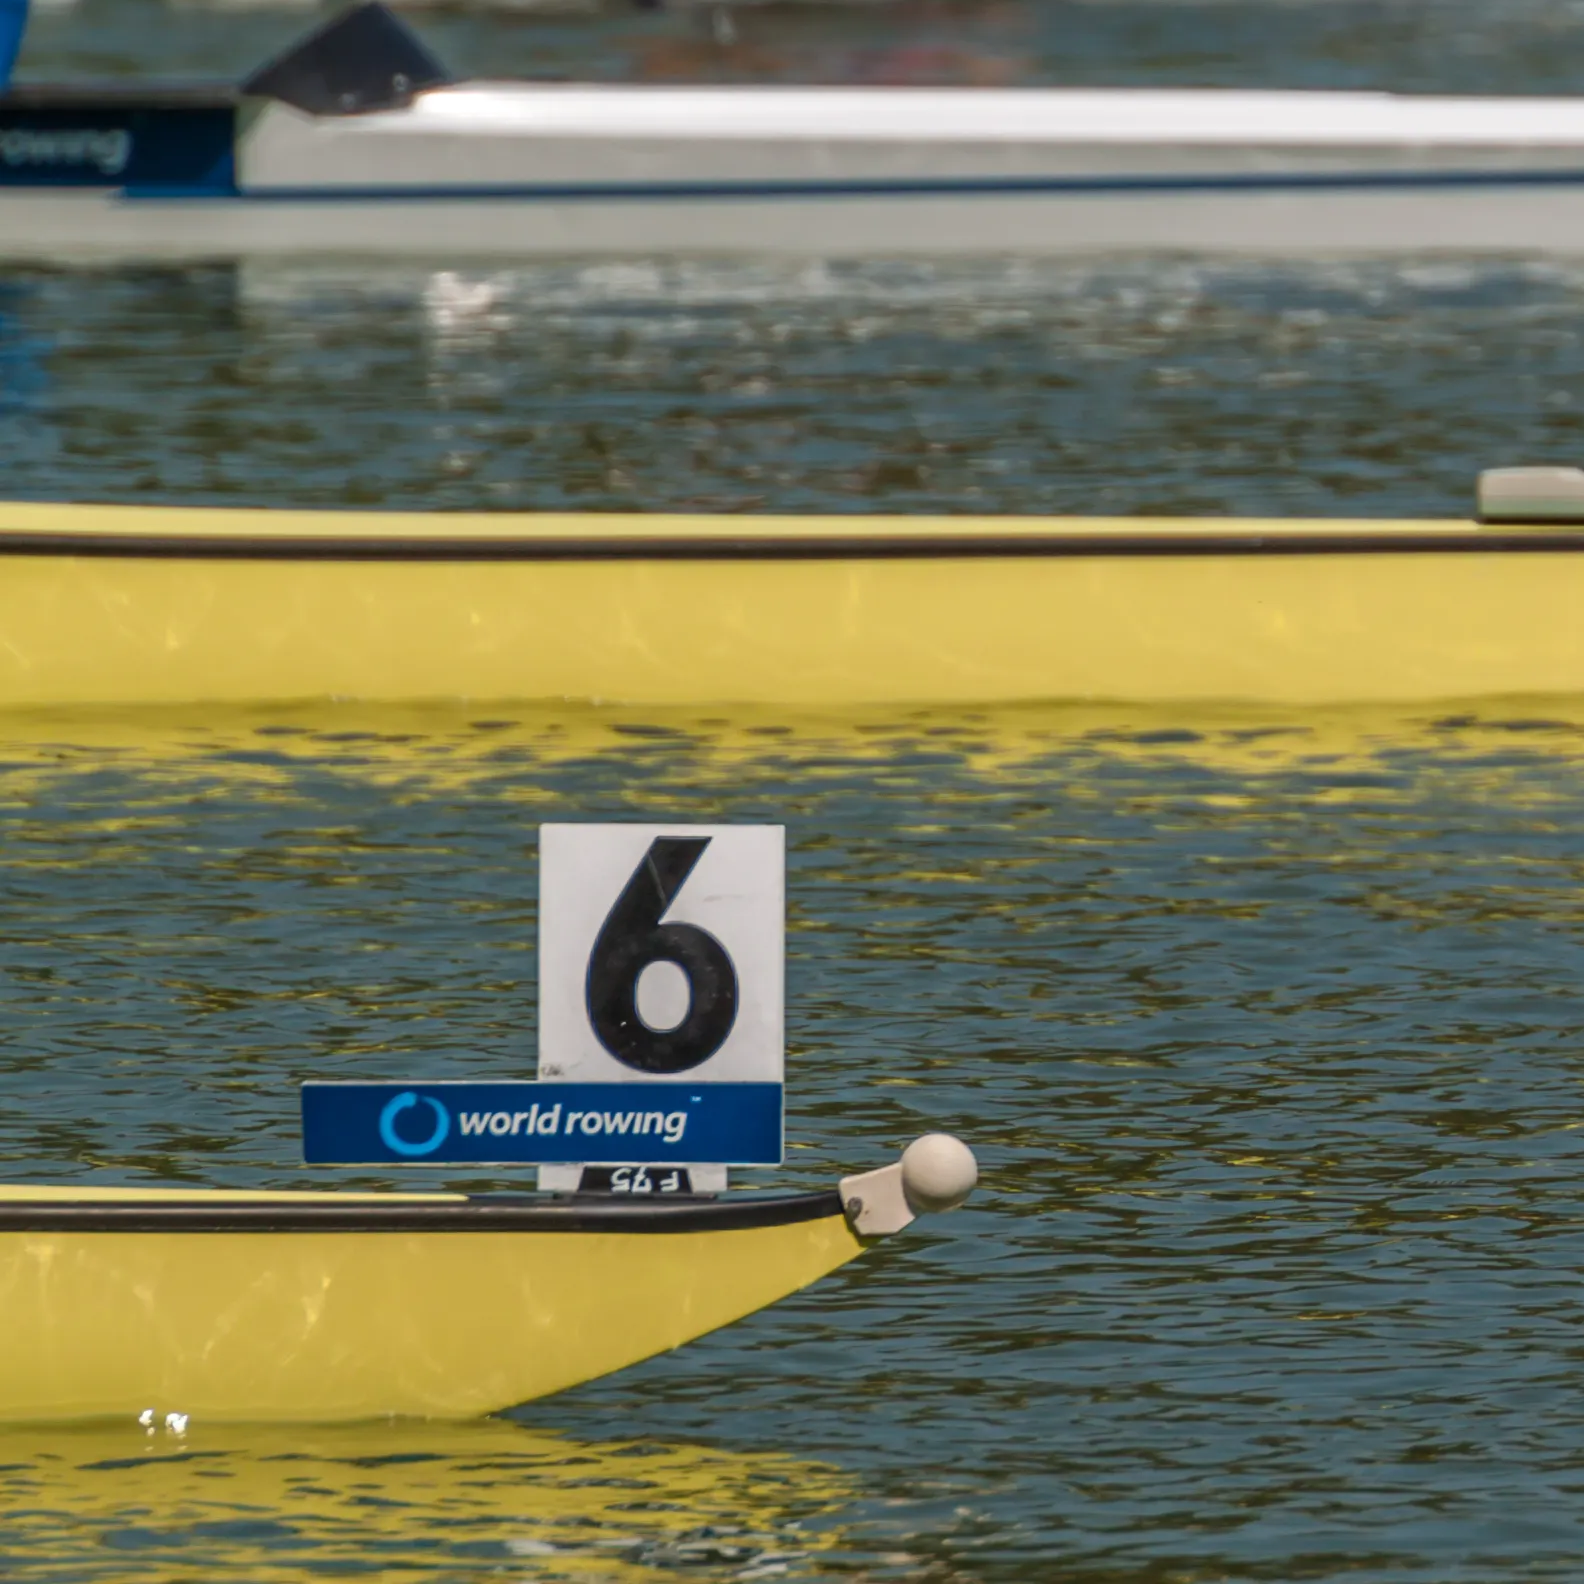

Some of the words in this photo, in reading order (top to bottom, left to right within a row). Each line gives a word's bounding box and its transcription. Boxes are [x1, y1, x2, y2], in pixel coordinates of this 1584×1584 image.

[586, 836, 738, 1074] 6
[459, 1103, 562, 1136] world
[564, 1111, 688, 1143] rowing
